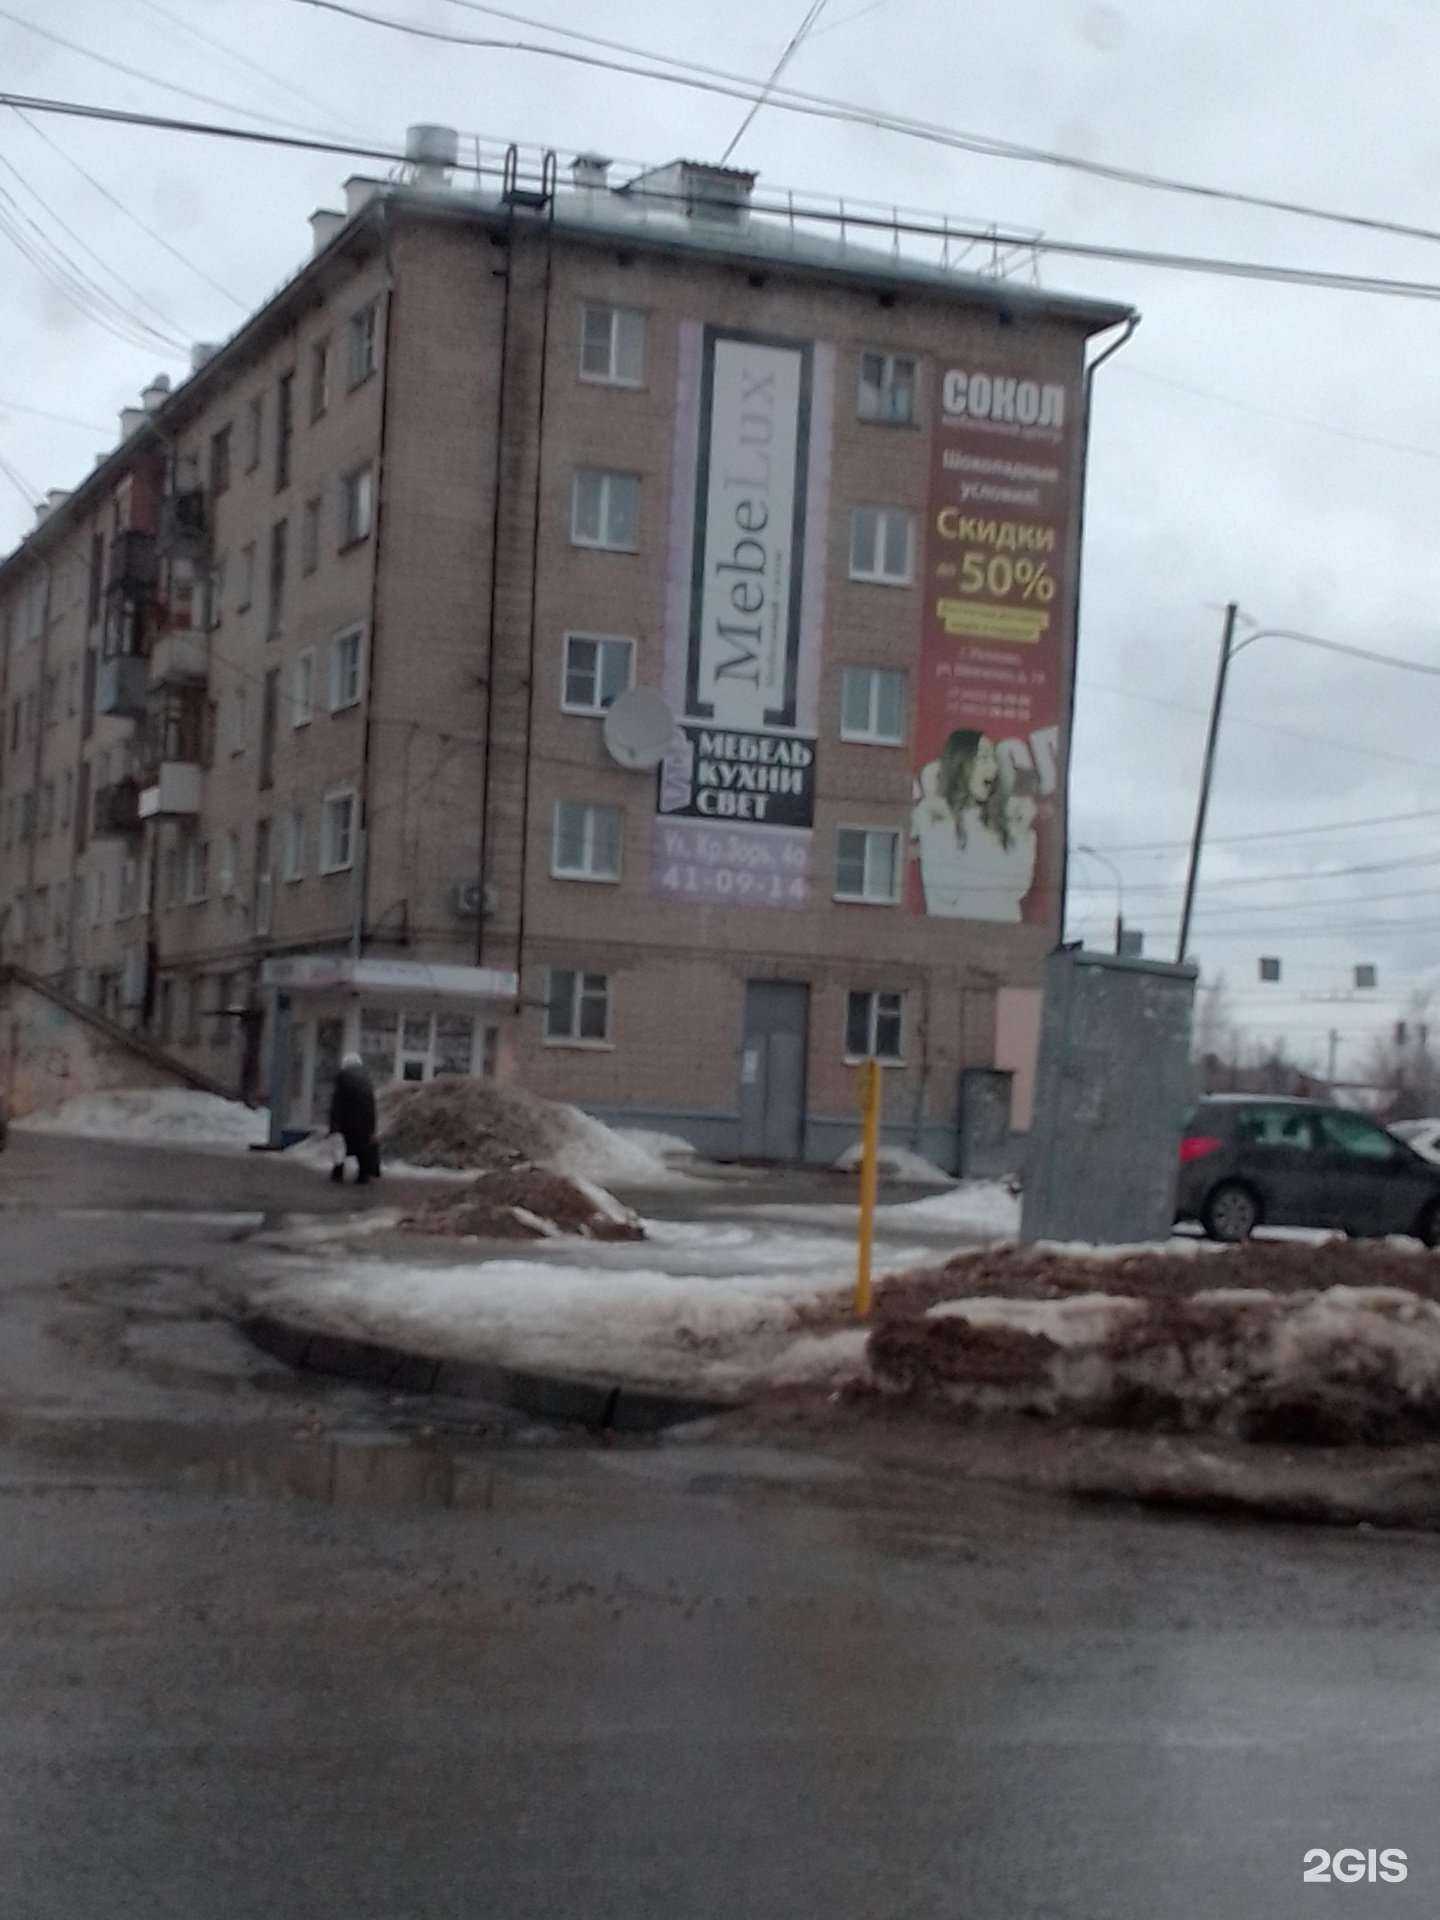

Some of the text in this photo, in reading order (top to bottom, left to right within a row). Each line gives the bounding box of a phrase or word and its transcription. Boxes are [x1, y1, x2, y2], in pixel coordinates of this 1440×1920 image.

[942, 369, 1065, 427] СОКОЛ
[960, 551, 1055, 601] 50%
[699, 730, 815, 768] МЕБЕЛЬ
[697, 760, 803, 795] КУХНИ
[696, 788, 769, 820] СВЕТ
